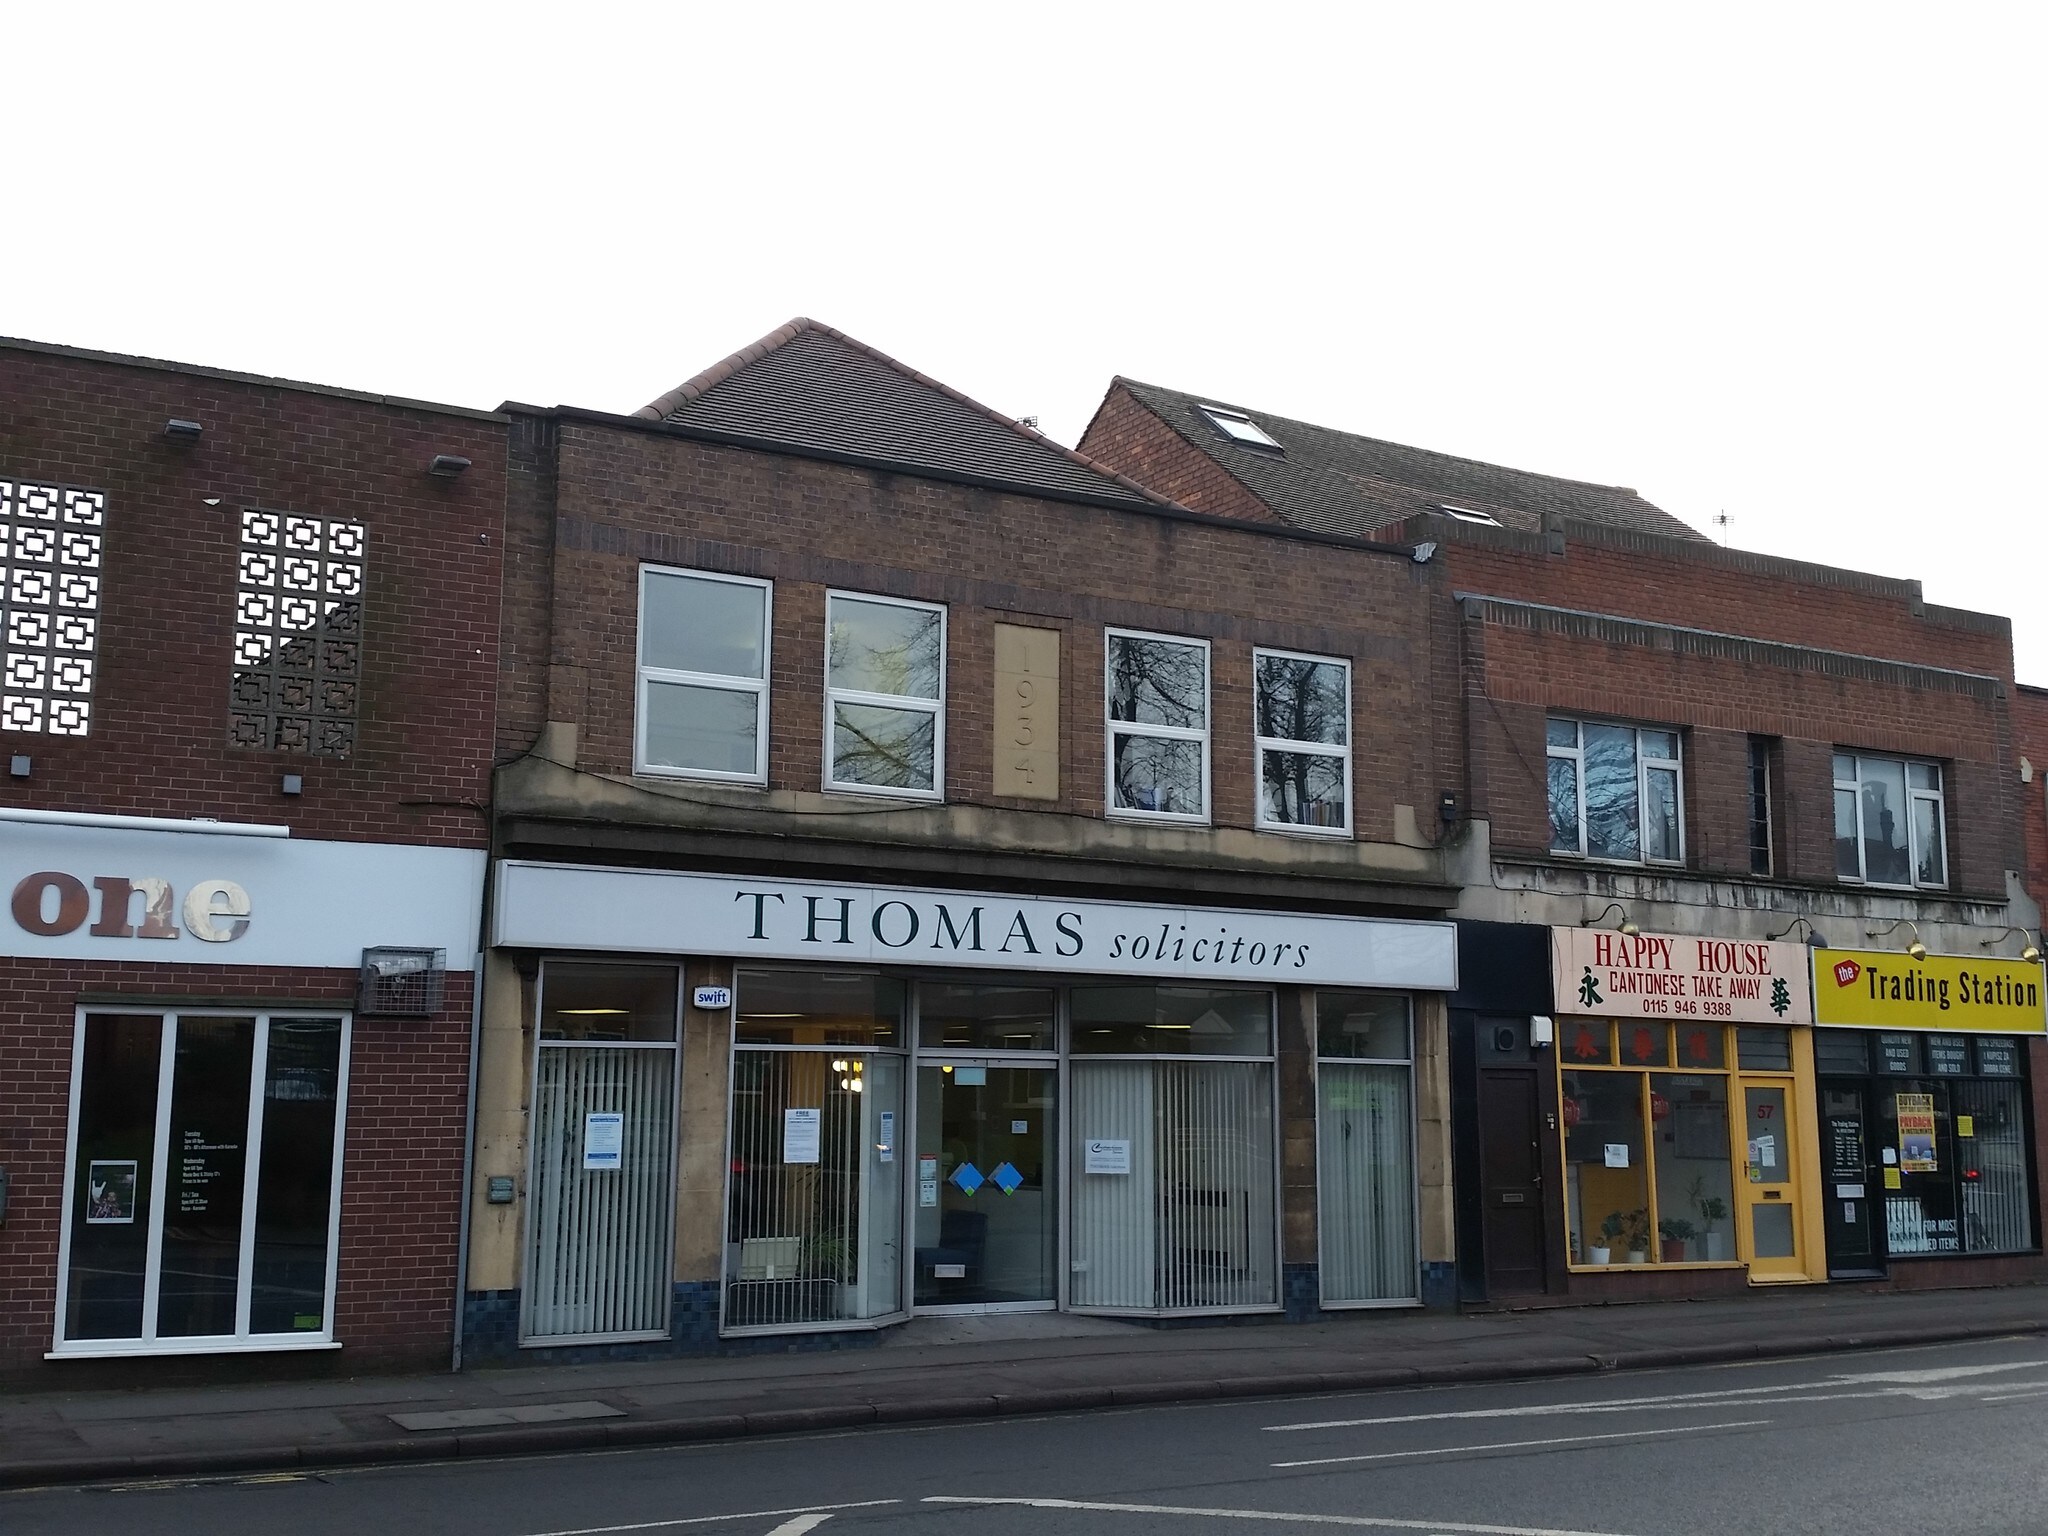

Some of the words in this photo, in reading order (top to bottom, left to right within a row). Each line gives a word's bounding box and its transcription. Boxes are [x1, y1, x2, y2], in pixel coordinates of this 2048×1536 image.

[1014, 645, 1036, 784] 1934
[11, 870, 251, 943] one
[734, 890, 1084, 957] THOMAS
[1109, 924, 1310, 968] solicitors
[1594, 933, 1674, 971] HAPPY
[1696, 940, 1772, 976] HOUSE
[1838, 966, 1854, 983] the
[1578, 966, 1604, 1009] 永
[1610, 971, 1686, 997] CANTONESE
[1692, 975, 1723, 998] TAKE
[1729, 978, 1761, 1000] AWAY
[1866, 967, 1951, 1011] Trading
[1959, 971, 2037, 1008] Station
[698, 990, 727, 1006] swift
[1769, 977, 1791, 1018] 華
[1643, 999, 1668, 1014] 0115
[1675, 1000, 1697, 1015] 946
[1703, 1001, 1732, 1017] 9388
[1941, 1037, 1952, 1047] AND
[1885, 1048, 1896, 1058] AND
[1896, 1048, 1909, 1058] USED
[1931, 1050, 1946, 1059] ITEMS
[1947, 1051, 1964, 1060] BOUGHT
[1890, 1061, 1907, 1071] GOODS
[1937, 1063, 1948, 1073] AND
[1949, 1064, 1960, 1073] SOLD
[1899, 1095, 1931, 1106] BUYBACK
[1757, 1105, 1775, 1119] 57
[1900, 1115, 1932, 1127] PAYBACK
[1924, 1220, 1937, 1232] FOR
[1938, 1219, 1957, 1232] MOST
[1939, 1238, 1959, 1251] ITEMS
